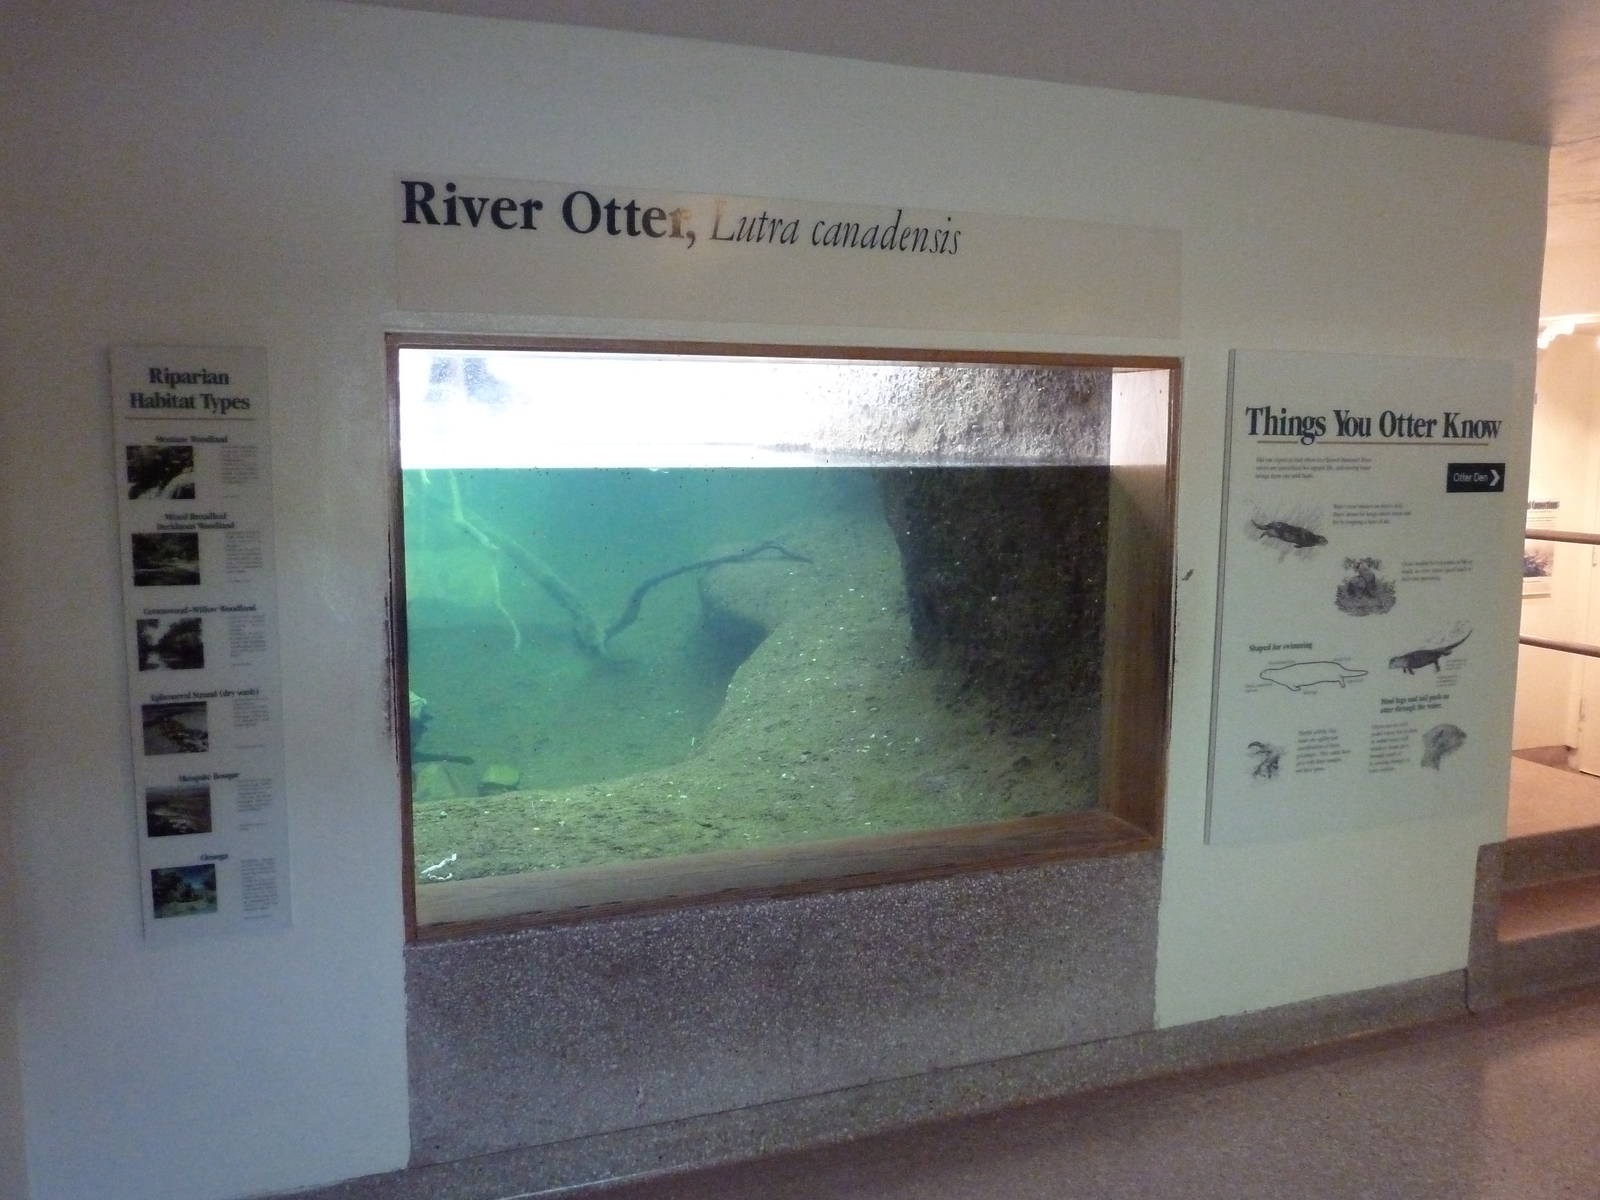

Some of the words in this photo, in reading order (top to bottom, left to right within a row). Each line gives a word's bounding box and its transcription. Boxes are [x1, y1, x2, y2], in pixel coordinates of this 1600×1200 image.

[400, 180, 543, 230] River
[562, 190, 696, 249] Otter,
[709, 199, 801, 245] Lutra
[811, 208, 962, 255] canadensis
[148, 367, 230, 389] Riparian
[129, 391, 196, 409] Habitat
[200, 393, 251, 415] Types
[1245, 405, 1327, 445] Things
[1332, 409, 1372, 438] You
[1378, 410, 1438, 439] Otter
[1442, 412, 1503, 439] Know
[1453, 472, 1473, 482] Otter
[1473, 472, 1489, 482] Den
